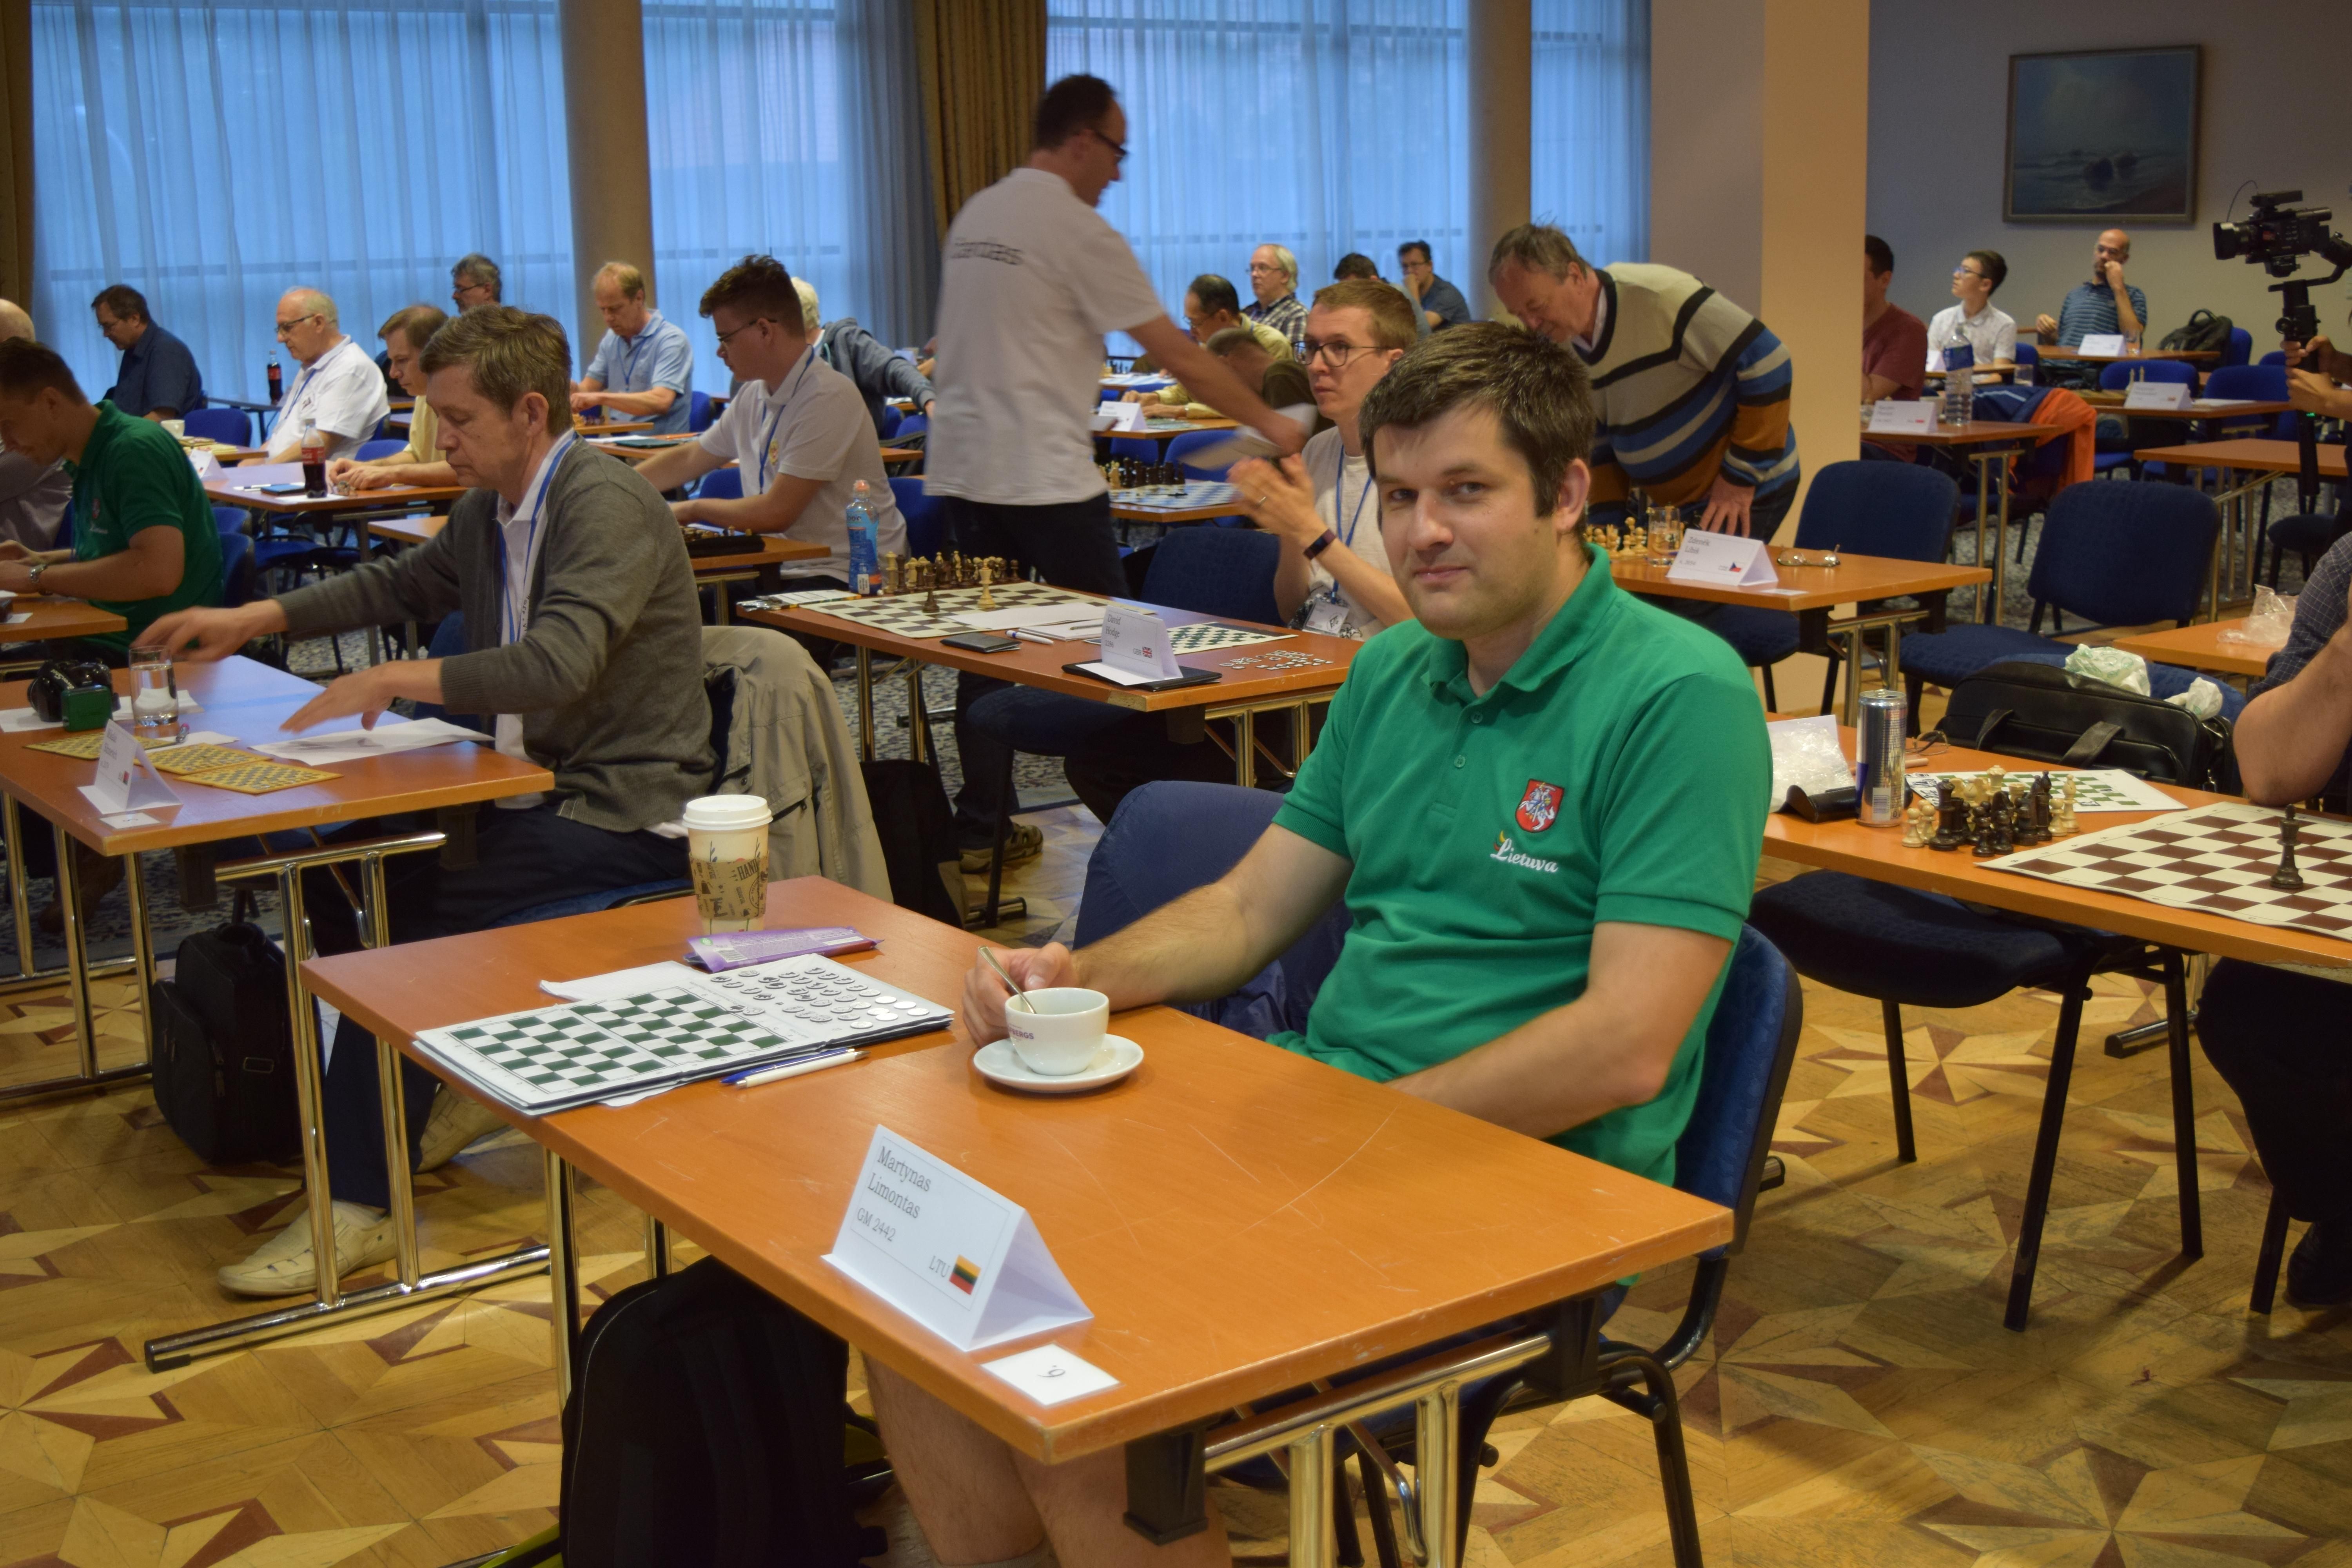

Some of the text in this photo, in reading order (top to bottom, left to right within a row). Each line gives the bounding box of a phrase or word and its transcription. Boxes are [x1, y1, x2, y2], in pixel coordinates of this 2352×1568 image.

[1105, 626, 1120, 639] Hodge
[1107, 614, 1121, 625] David
[1490, 838, 1559, 873] Lietuva
[1009, 1027, 1034, 1040] FBERGS
[877, 1146, 932, 1192] Martynas
[867, 1172, 920, 1219] Limontas
[857, 1208, 896, 1242] GM 2442
[929, 1255, 950, 1279] LTU
